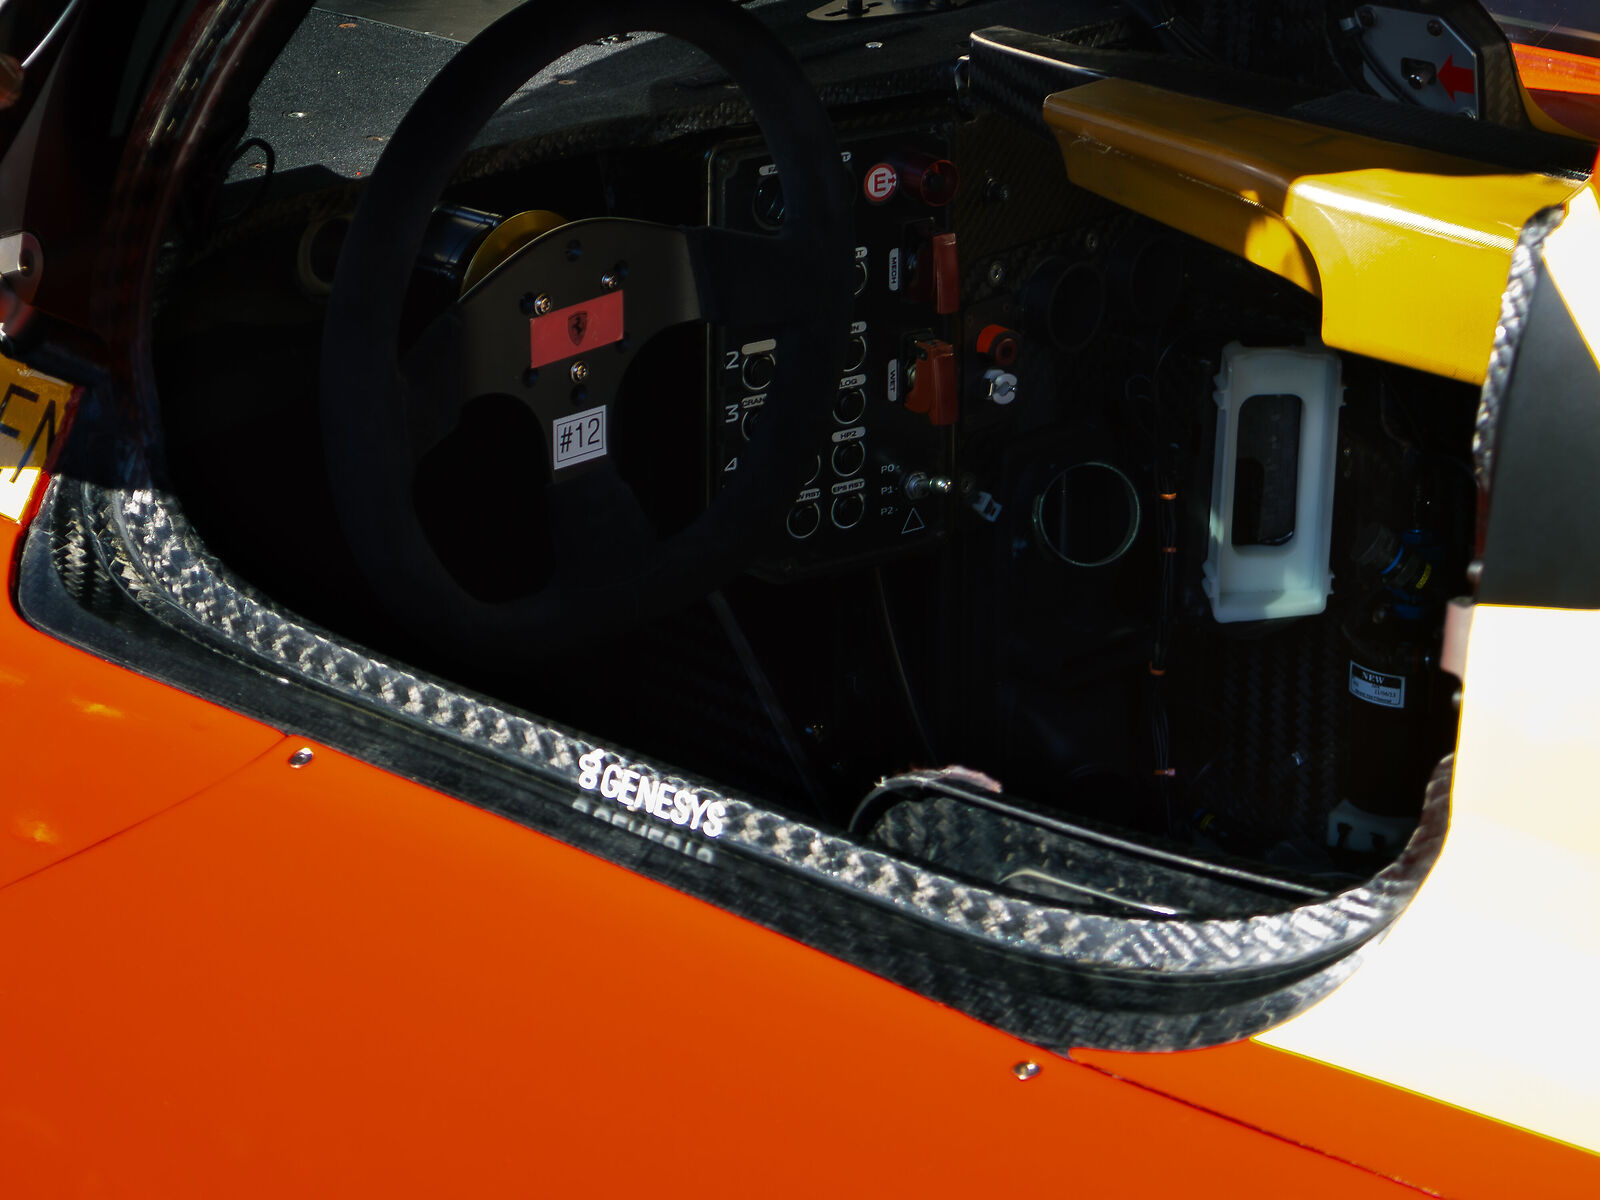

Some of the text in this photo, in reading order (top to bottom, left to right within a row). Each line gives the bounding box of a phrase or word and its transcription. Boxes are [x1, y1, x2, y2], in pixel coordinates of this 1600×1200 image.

[874, 173, 887, 193] E
[890, 256, 898, 285] MECH
[724, 350, 740, 370] 2
[840, 377, 858, 388] LOG
[889, 369, 897, 391] WET
[725, 403, 739, 423] 3
[560, 417, 601, 453] #12
[1361, 671, 1384, 685] NEW
[600, 763, 726, 838] GENESYS
